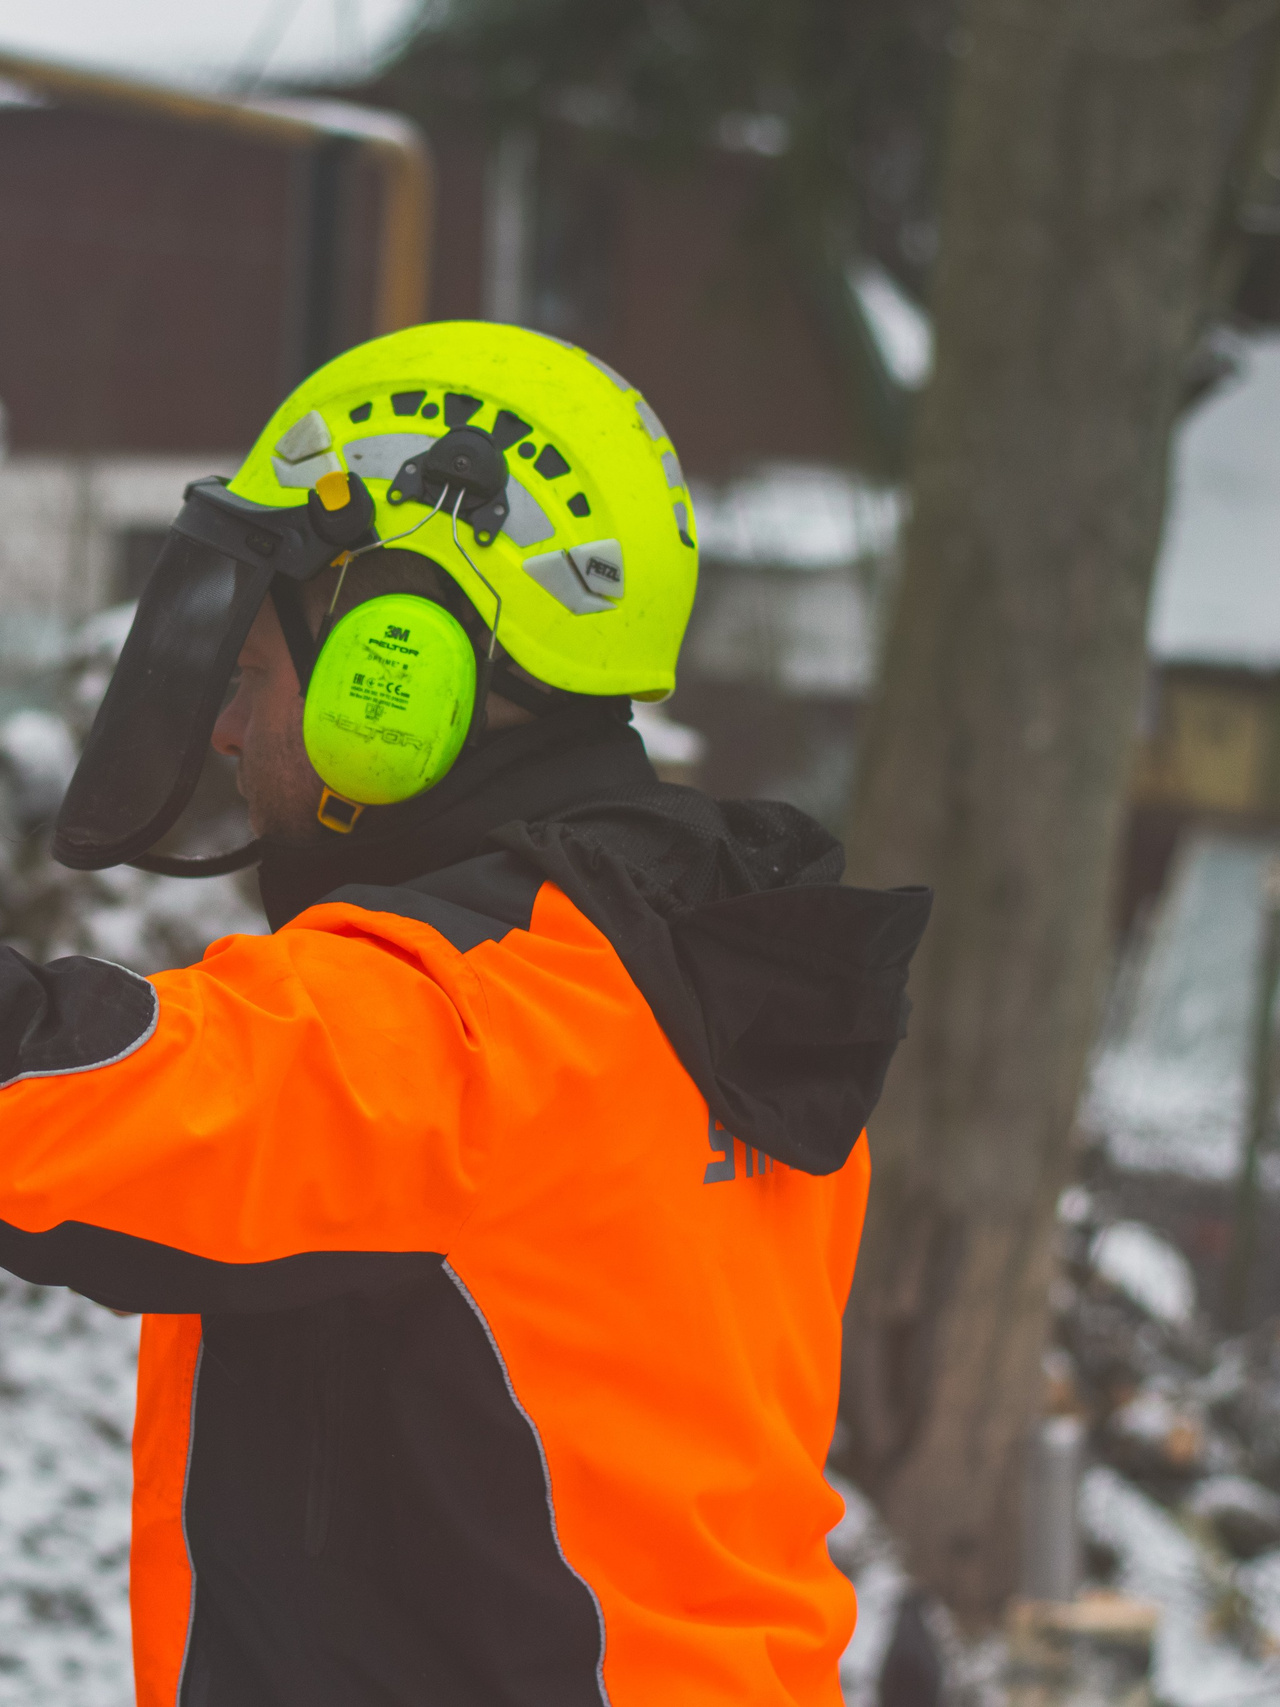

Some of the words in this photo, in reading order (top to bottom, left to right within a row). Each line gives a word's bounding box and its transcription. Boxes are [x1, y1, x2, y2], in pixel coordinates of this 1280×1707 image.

[586, 557, 620, 582] PETZL
[385, 625, 410, 642] 3M
[369, 638, 419, 656] PELTOR
[318, 711, 422, 749] PELTOR
